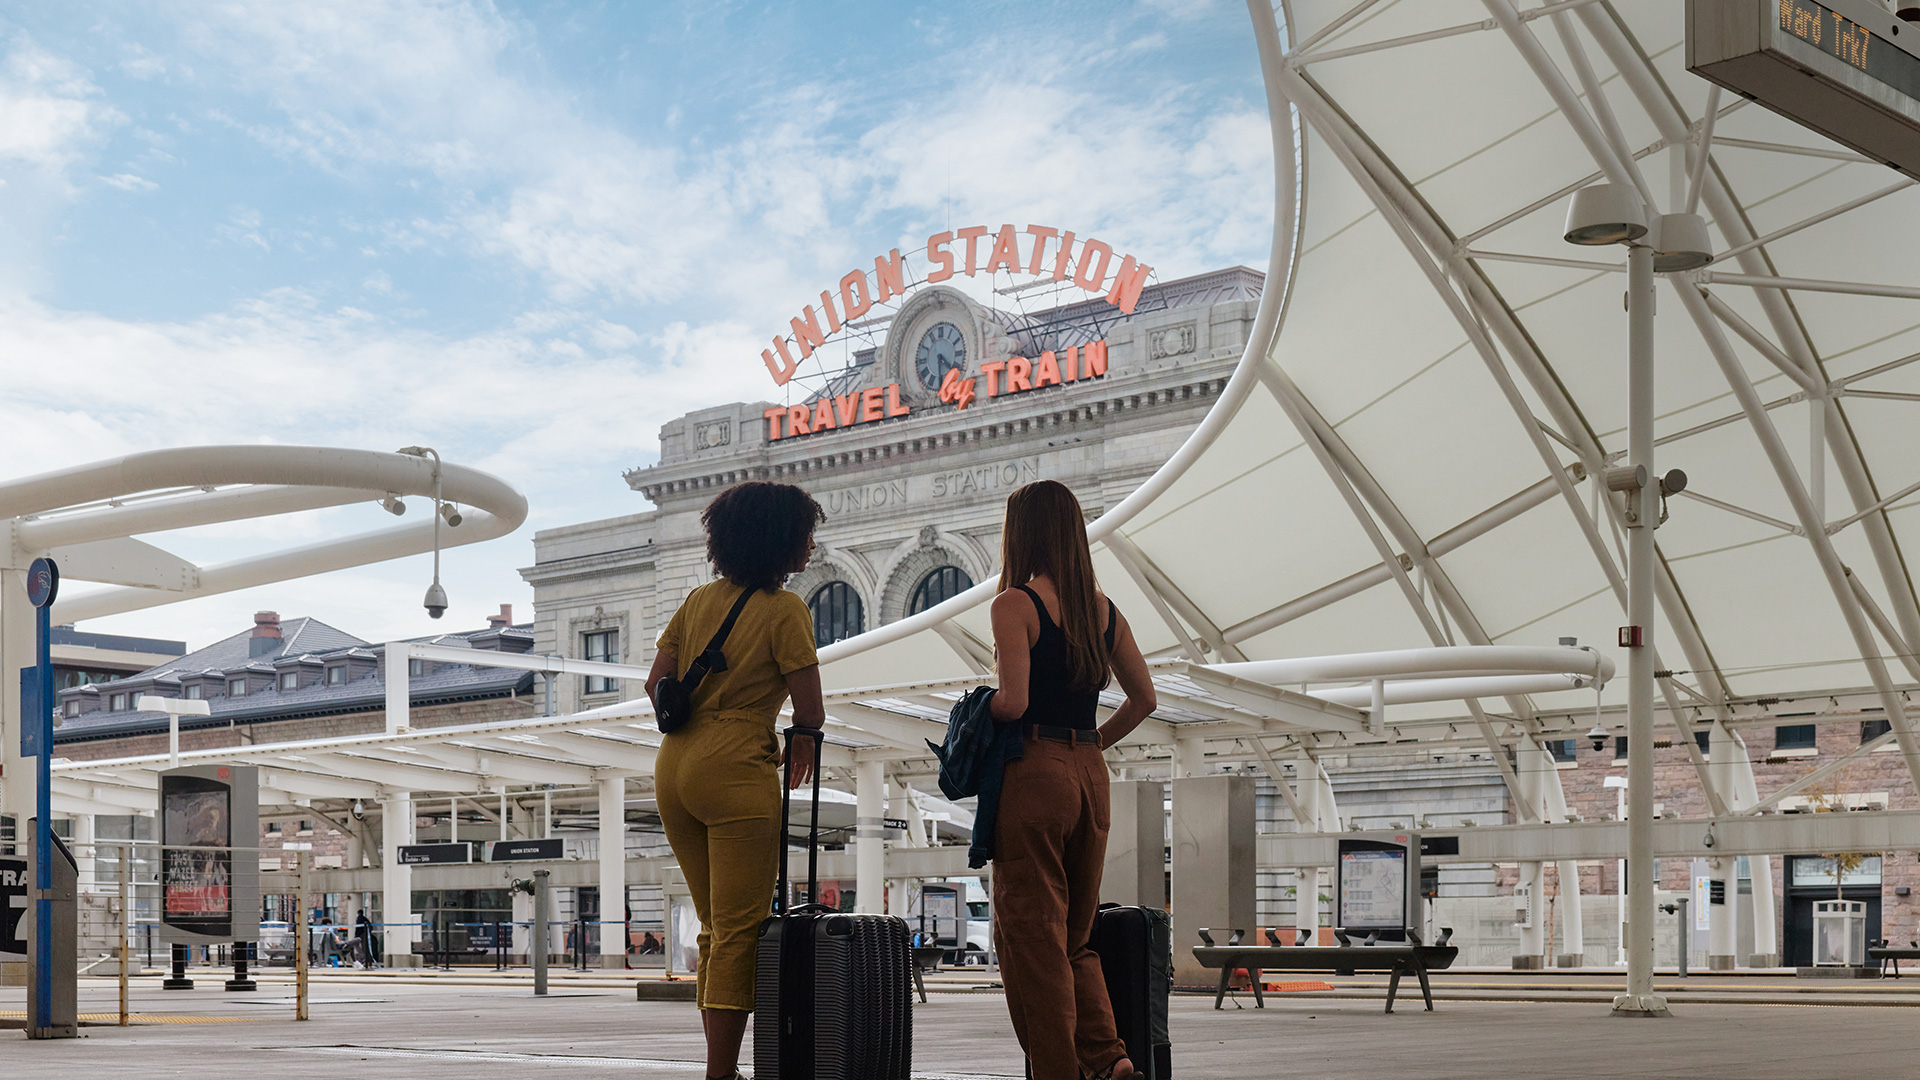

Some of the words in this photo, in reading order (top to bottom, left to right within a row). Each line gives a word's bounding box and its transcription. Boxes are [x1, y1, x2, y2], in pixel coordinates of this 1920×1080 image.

[1780, 0, 1821, 45] Ward
[1832, 11, 1870, 70] Trk7
[761, 247, 906, 387] UNION
[927, 223, 1154, 315] STATION
[763, 382, 911, 442] TRAVEL
[937, 367, 976, 411] by
[980, 338, 1109, 398] TRAIN
[828, 480, 908, 515] UNION
[931, 457, 1040, 498] STATION
